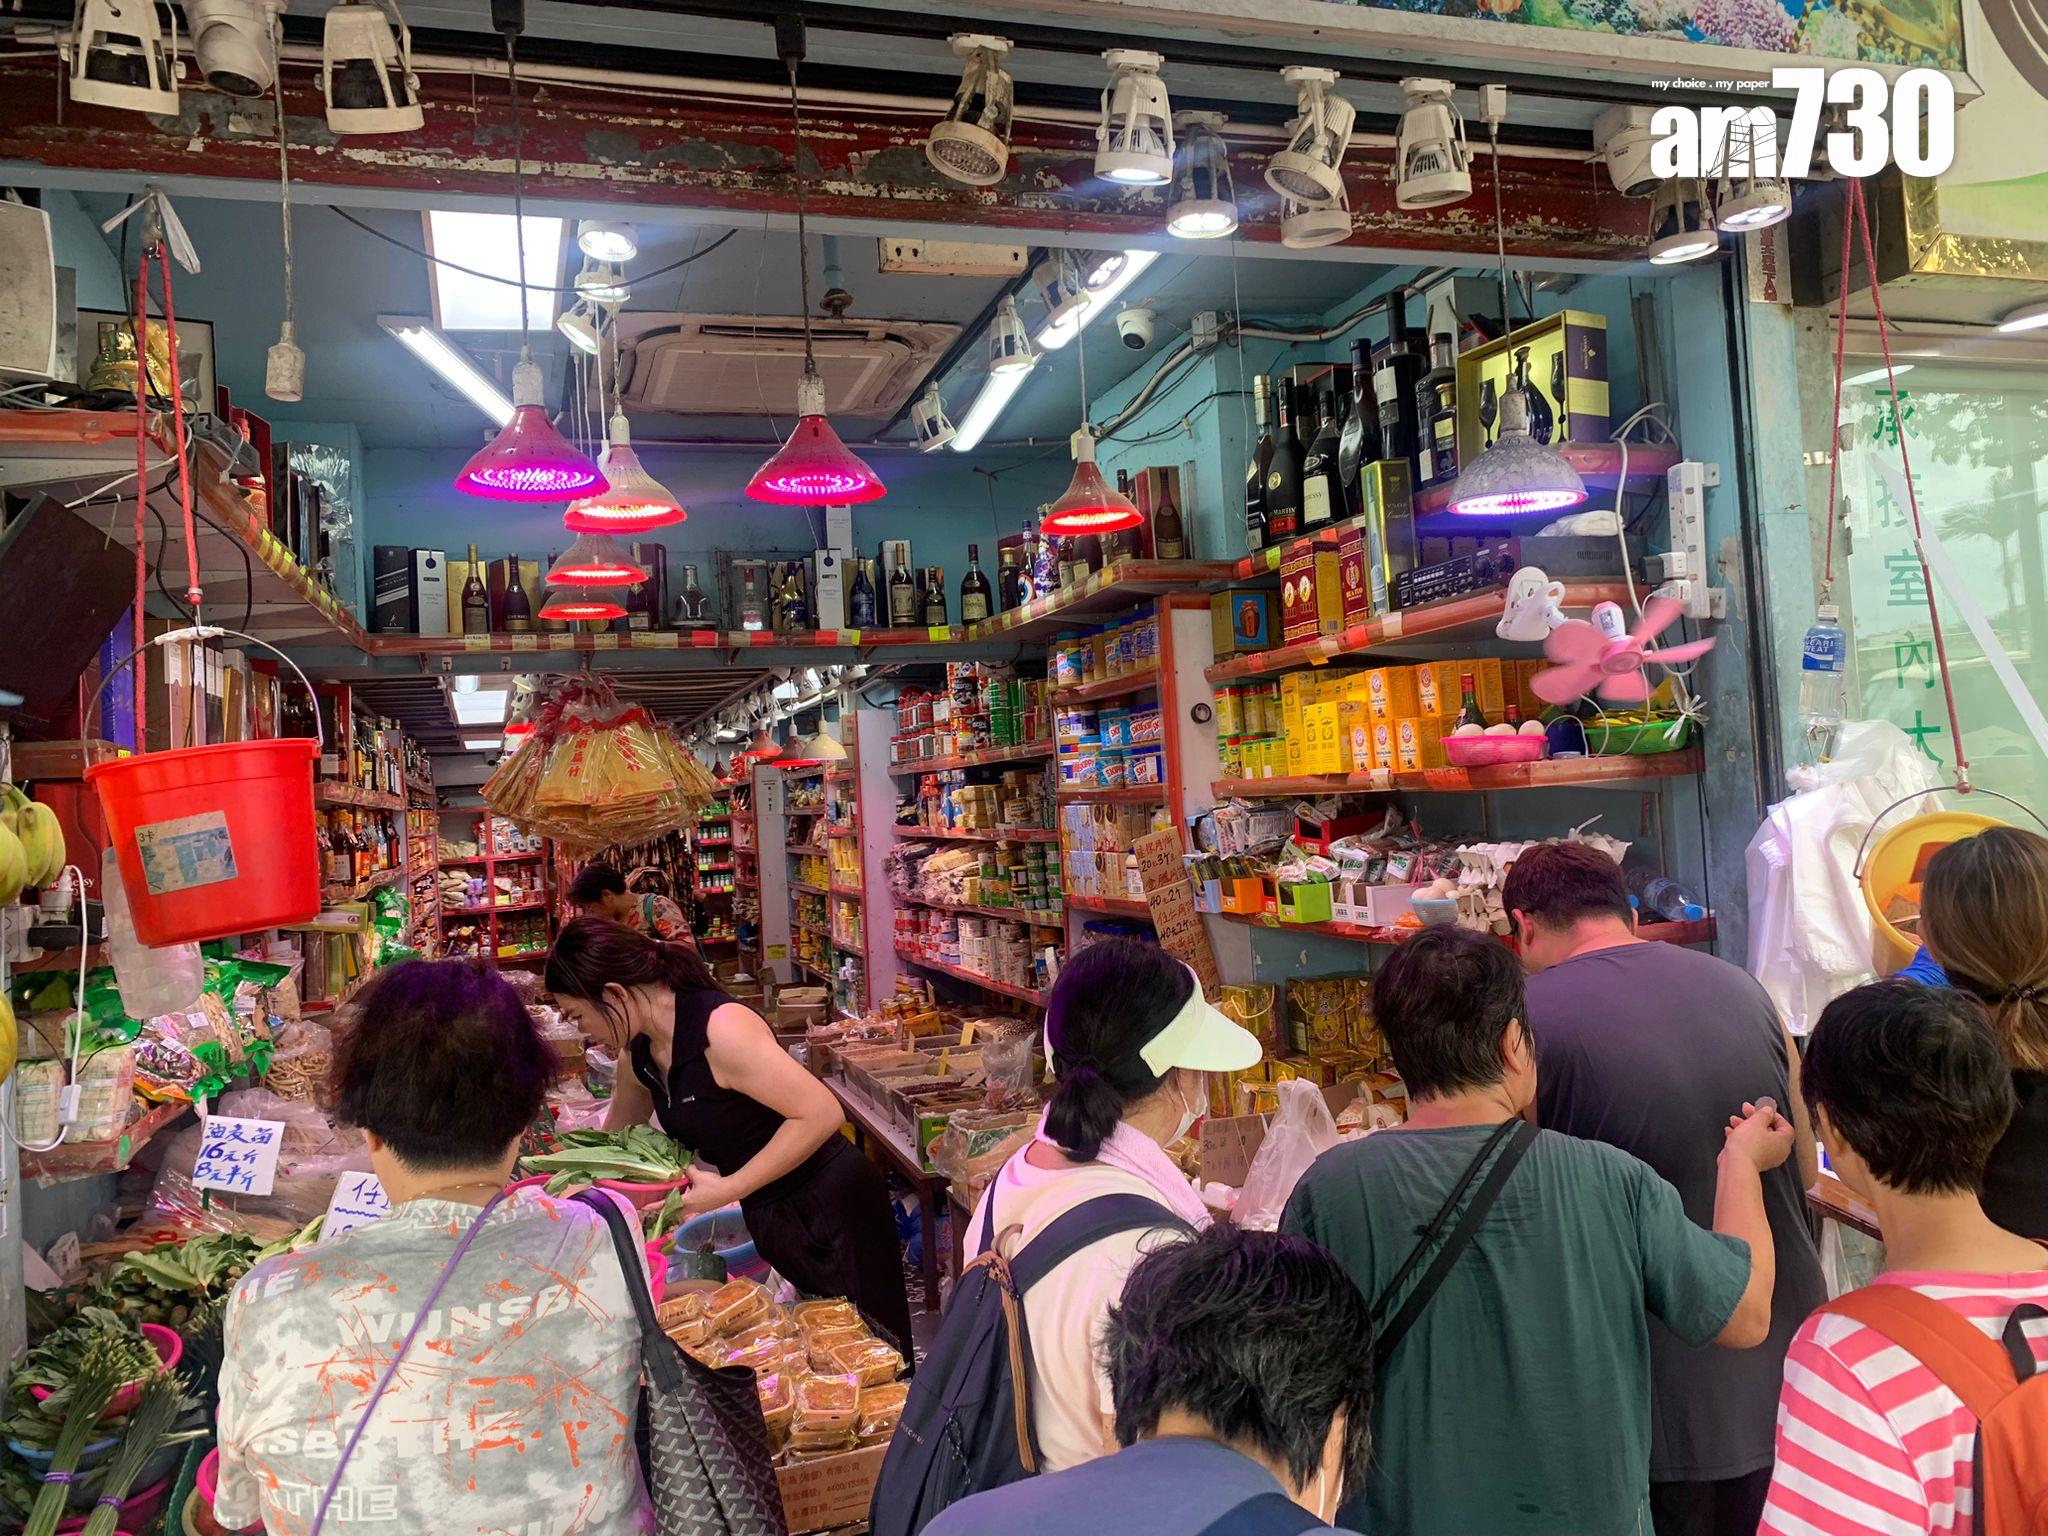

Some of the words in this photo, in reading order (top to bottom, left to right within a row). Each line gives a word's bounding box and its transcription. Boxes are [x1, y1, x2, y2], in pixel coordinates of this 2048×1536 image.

[198, 1142, 259, 1164] 16元斤
[193, 1162, 257, 1192] 8元半斤
[352, 1178, 391, 1210] 任
